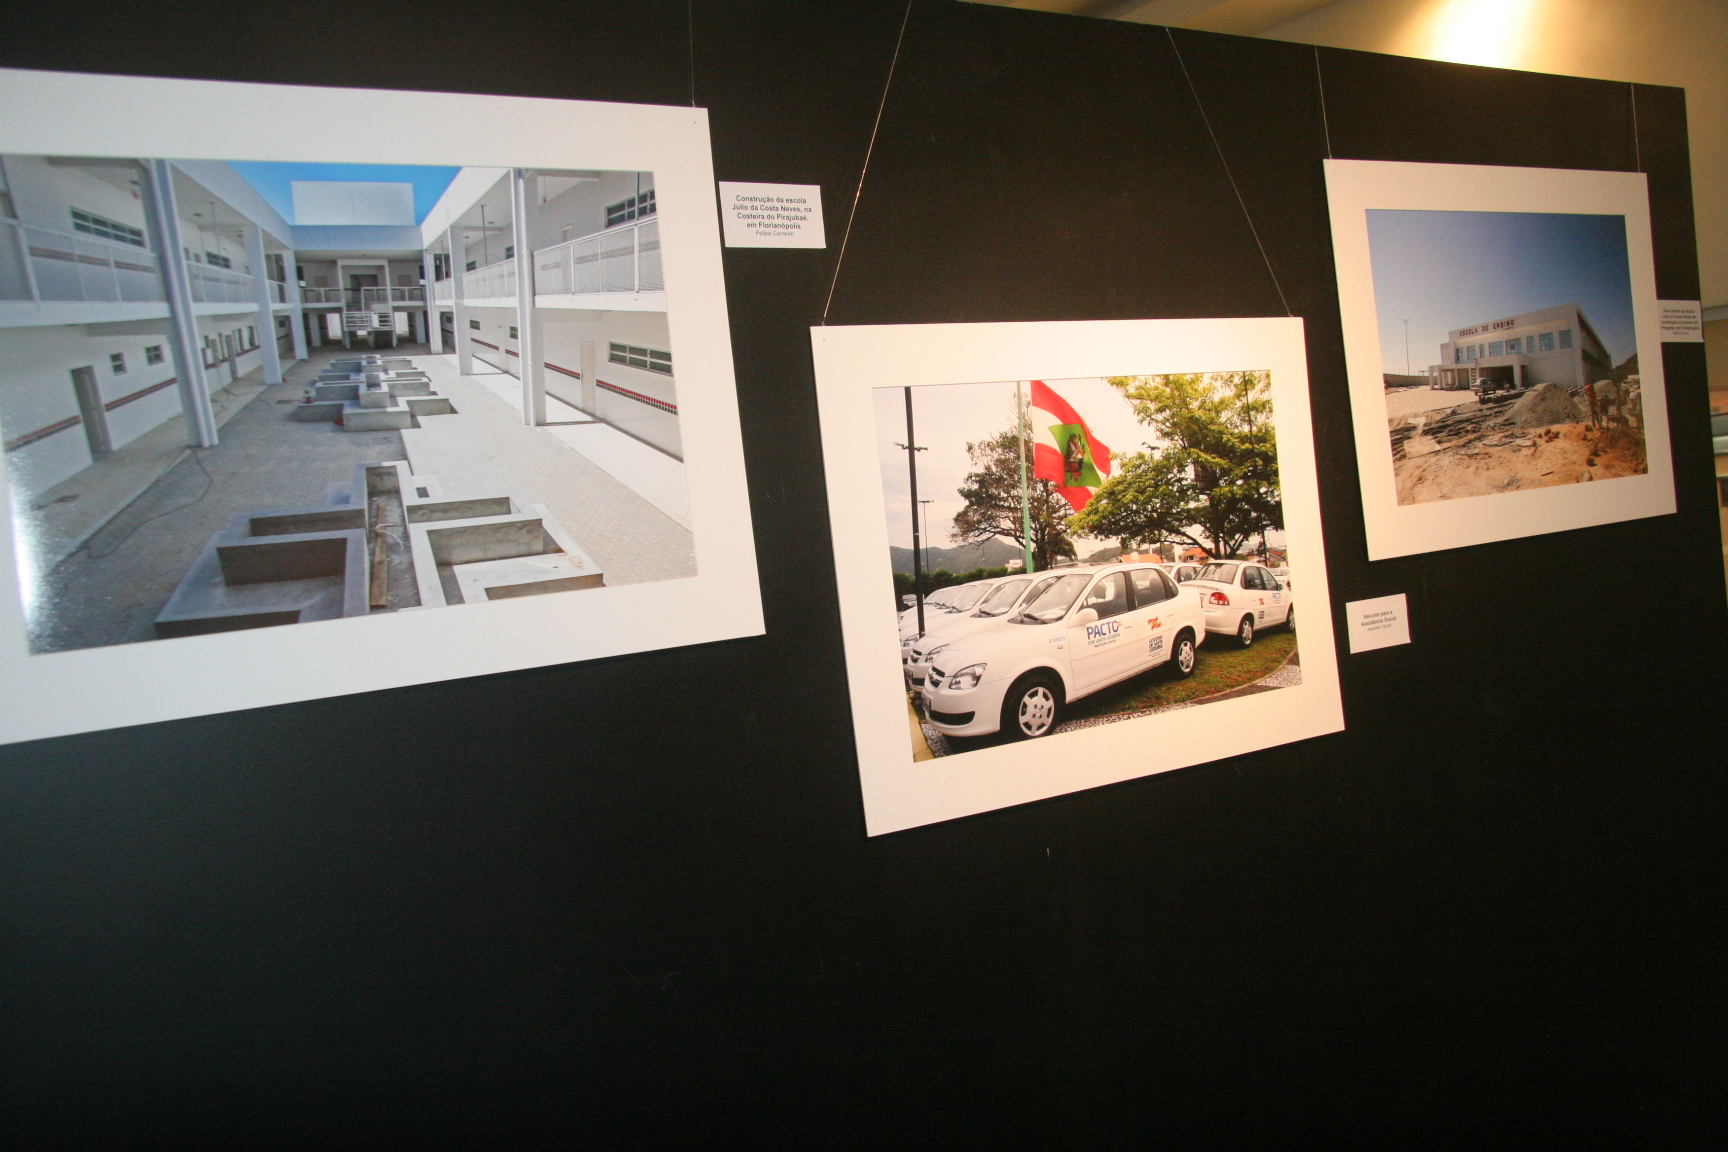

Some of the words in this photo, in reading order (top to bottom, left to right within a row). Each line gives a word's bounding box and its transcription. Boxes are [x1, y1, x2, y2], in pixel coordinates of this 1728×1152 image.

[736, 195, 774, 204] Construção
[758, 222, 801, 230] Florianópolis
[1086, 620, 1120, 640] PACTO
